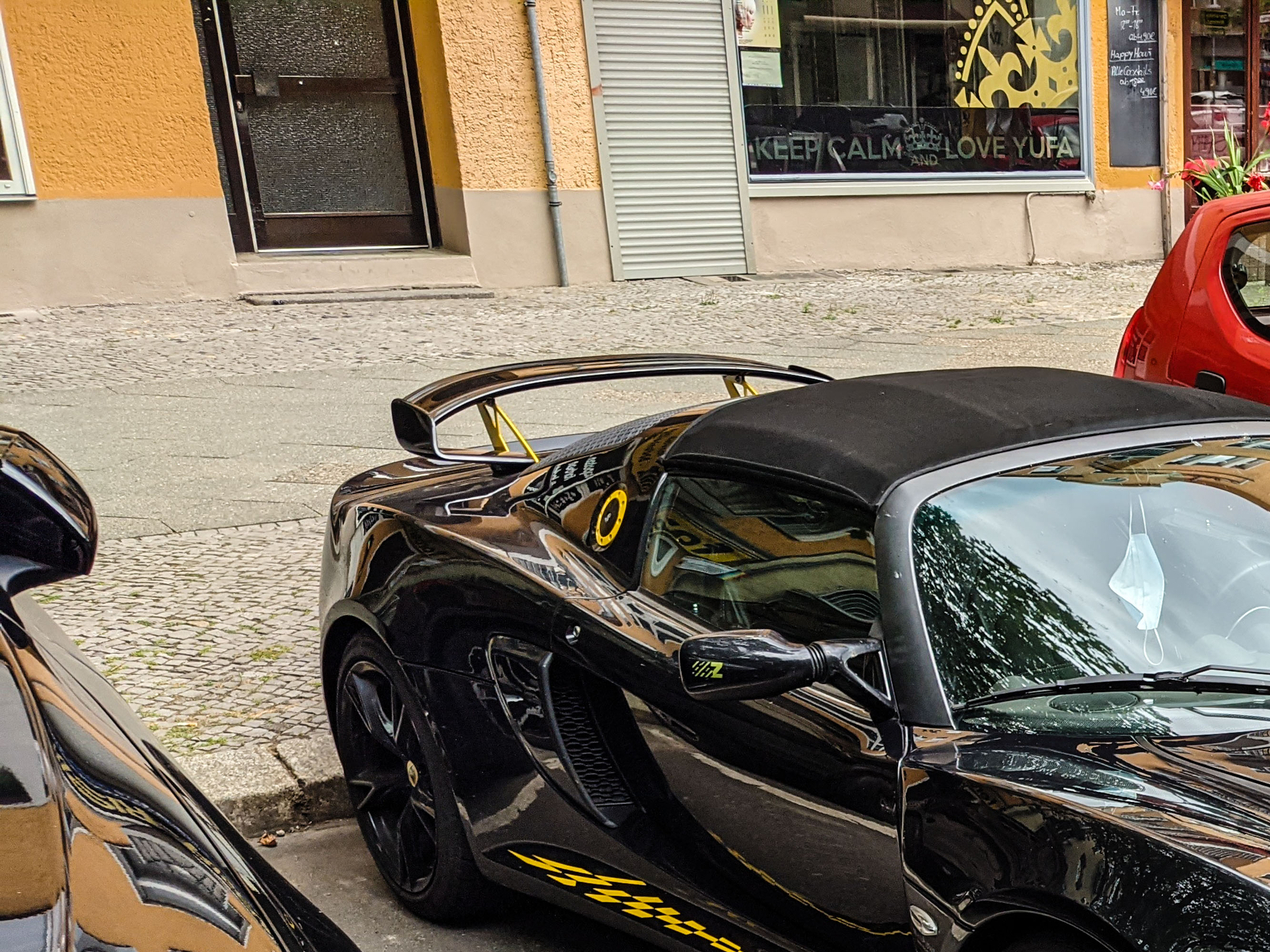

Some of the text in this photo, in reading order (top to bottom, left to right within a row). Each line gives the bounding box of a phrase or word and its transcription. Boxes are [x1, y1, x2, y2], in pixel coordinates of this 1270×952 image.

[1110, 49, 1133, 61] Happy
[755, 135, 1075, 167] KEEP CALM AND LOVE YUFA
